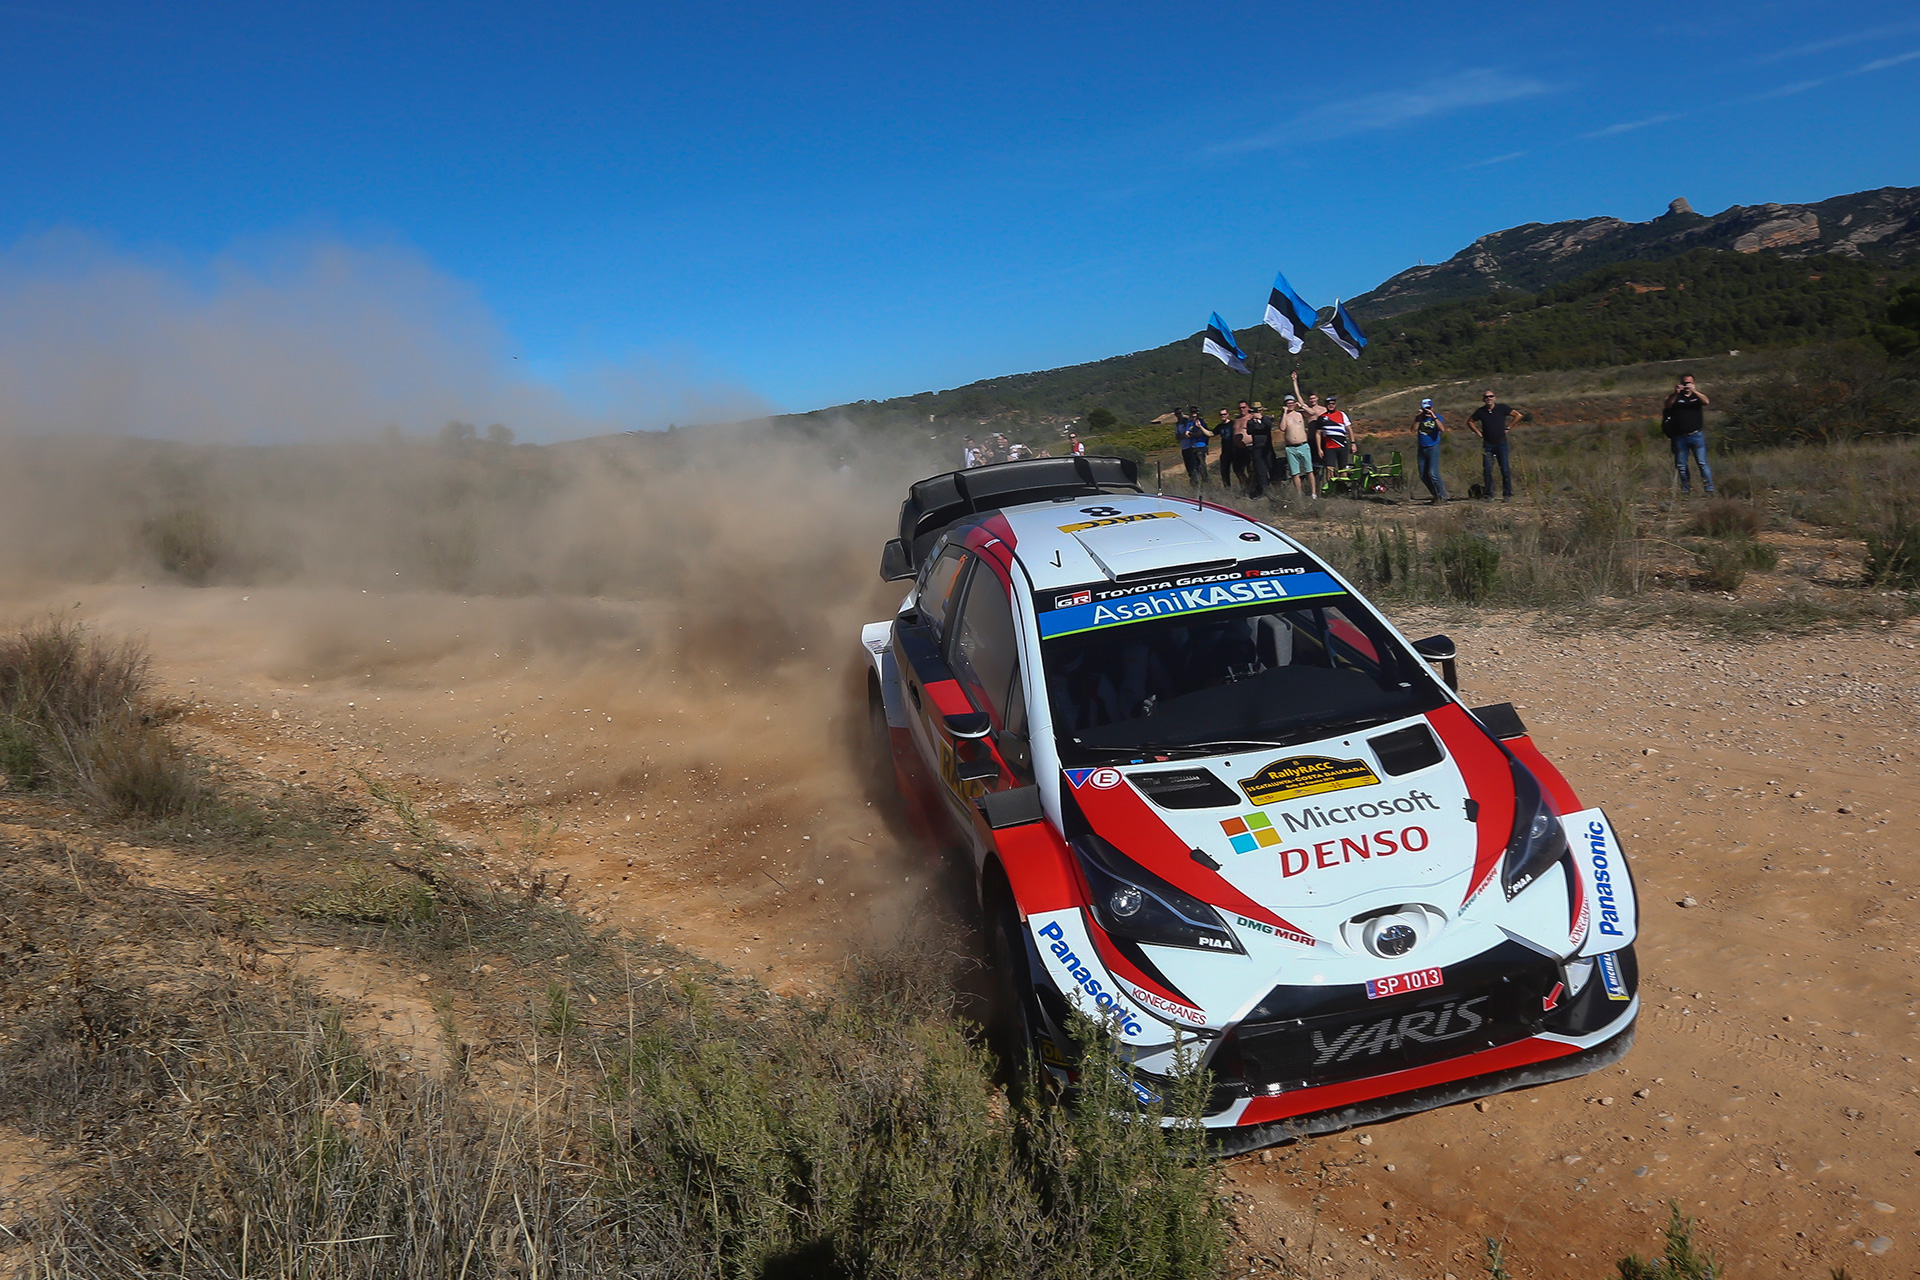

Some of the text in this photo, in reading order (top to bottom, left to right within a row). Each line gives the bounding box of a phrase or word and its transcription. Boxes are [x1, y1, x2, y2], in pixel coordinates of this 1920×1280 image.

[1079, 506, 1122, 517] 8
[1079, 514, 1159, 529] RACC
[1096, 567, 1306, 599] TOYOTA GAZOO Racing
[1093, 580, 1288, 624] AsahiKASEI
[1100, 773, 1113, 784] E
[1267, 761, 1335, 780] RallyRACC
[1324, 766, 1367, 777] DAURADA
[1281, 789, 1441, 833] Microsoft
[1278, 826, 1429, 879] DENSO
[1584, 821, 1624, 936] Panasonic
[1198, 936, 1233, 950] PIAA
[1236, 916, 1317, 947] DMG MORI
[1038, 920, 1143, 1037] Panasonic
[1377, 969, 1439, 995] SP 1013
[1603, 953, 1618, 987] MICHELI
[1132, 987, 1207, 1026] KONECRANES
